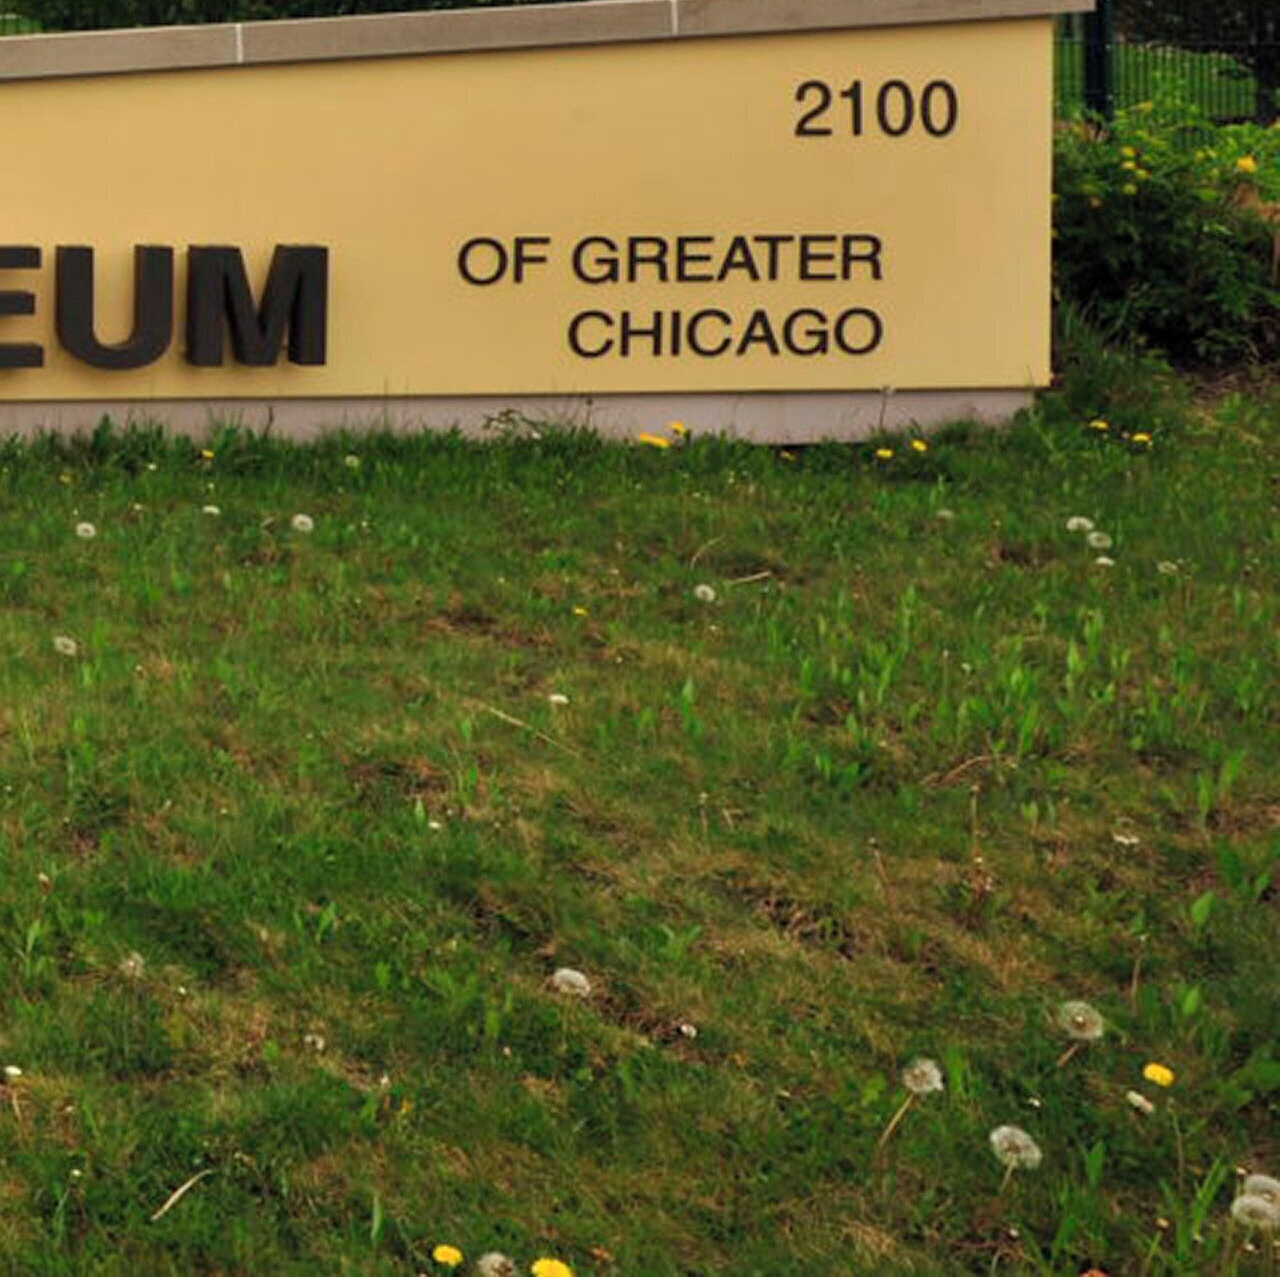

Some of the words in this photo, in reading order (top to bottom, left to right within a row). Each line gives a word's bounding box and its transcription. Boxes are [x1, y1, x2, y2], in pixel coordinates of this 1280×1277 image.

[793, 79, 959, 139] 2100
[456, 234, 553, 288] OF
[570, 233, 883, 286] GREATER
[566, 306, 884, 360] CHICAGO
